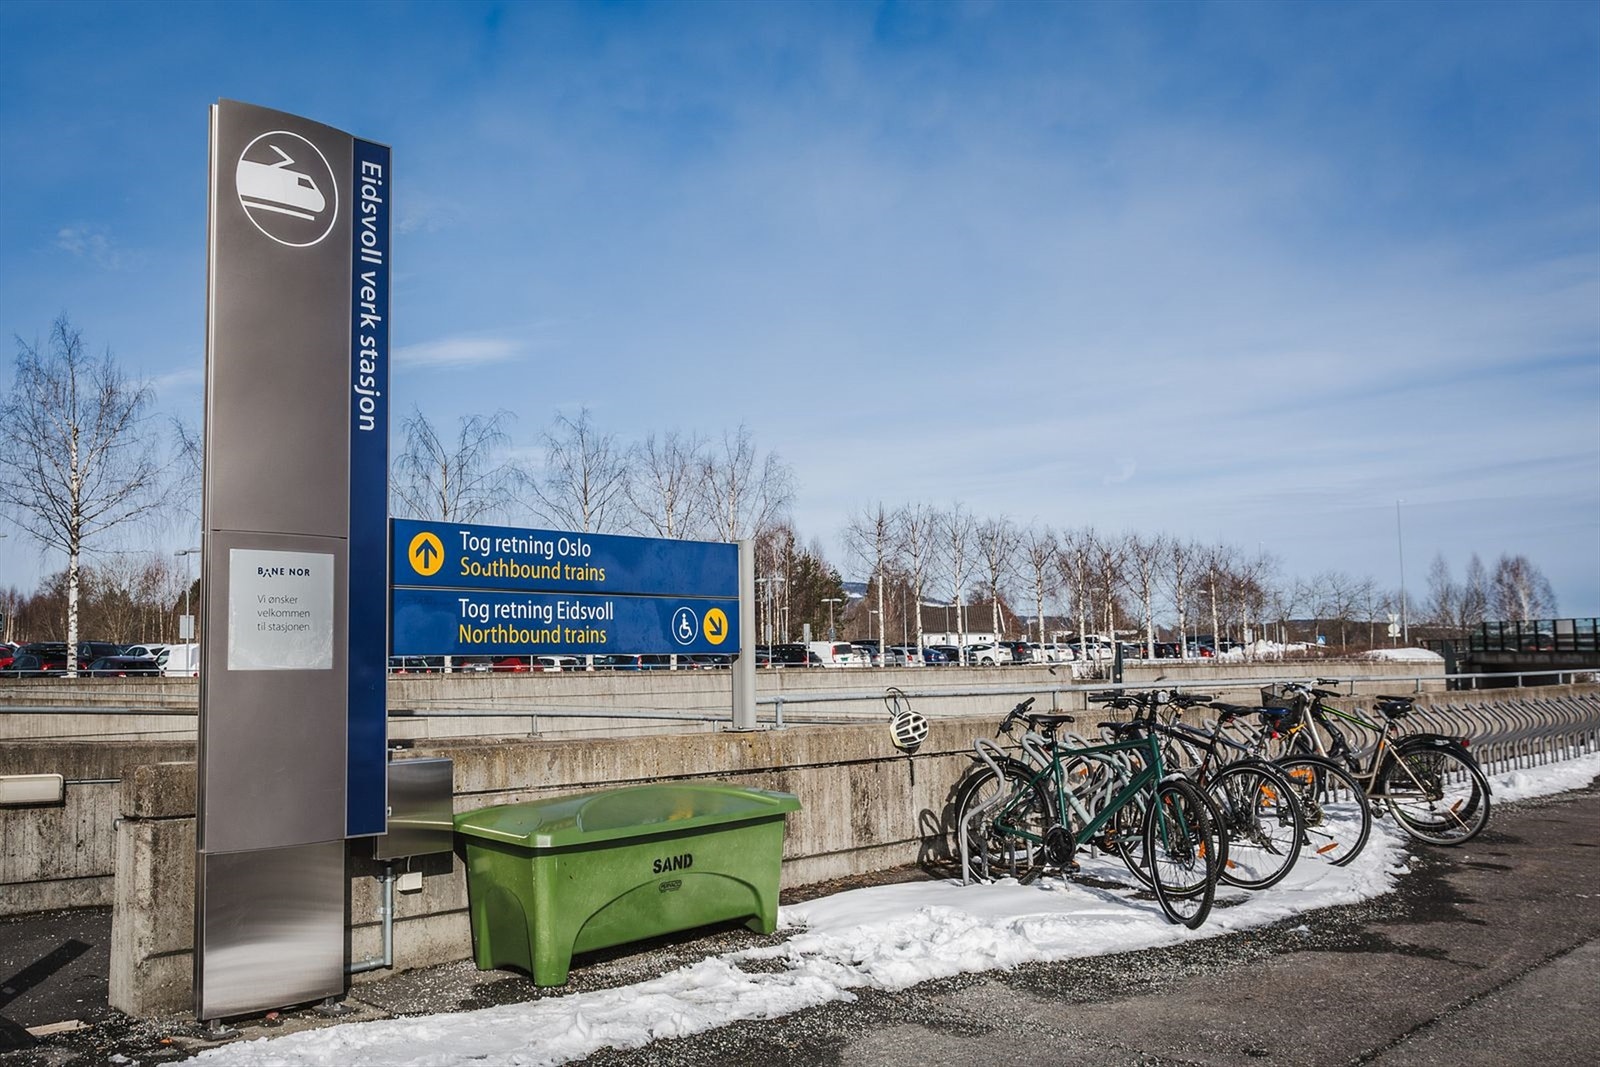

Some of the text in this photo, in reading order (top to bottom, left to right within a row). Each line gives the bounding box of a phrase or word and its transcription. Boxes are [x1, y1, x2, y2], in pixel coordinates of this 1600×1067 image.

[353, 160, 382, 432] Eidsvoll verk stasjon
[459, 530, 591, 560] Tog retning Oslo
[257, 566, 311, 578] BANE NOR
[460, 556, 606, 582] Southbound trains
[257, 594, 299, 605] Vi ønsker
[257, 608, 311, 618] velkommen
[458, 598, 614, 624] Tog retning Eidsvoll
[257, 621, 311, 634] til stasjonen
[459, 623, 607, 644] Northbound trains
[652, 853, 694, 874] SAND
